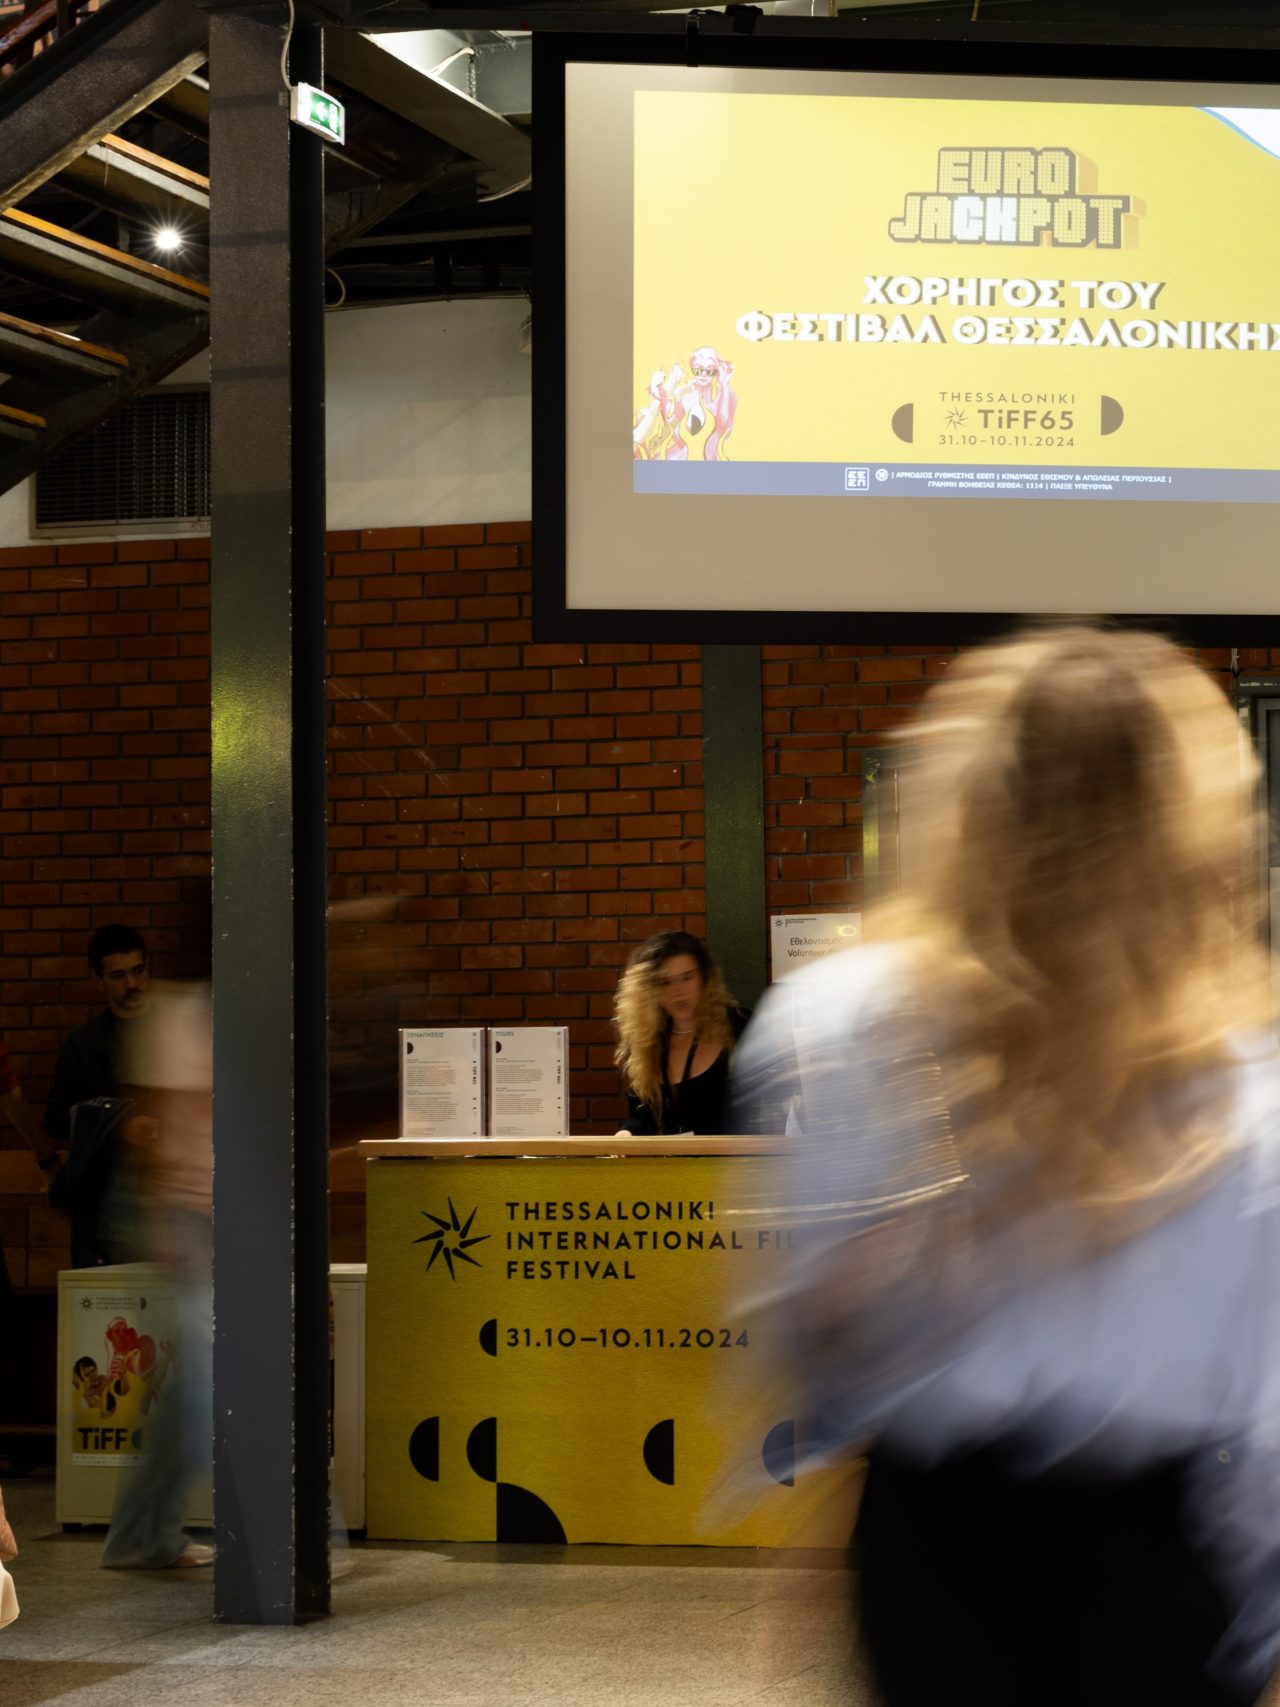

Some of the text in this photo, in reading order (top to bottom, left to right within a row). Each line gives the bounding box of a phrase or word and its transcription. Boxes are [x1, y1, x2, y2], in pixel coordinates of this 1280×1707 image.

[938, 147, 1075, 194] EURO
[889, 193, 1130, 248] JACKPOT
[863, 276, 1166, 310] ΧΟΡΗΓΟΣ ΤΟΥ
[736, 310, 947, 344] ΦΕΣΤΙΒΑΛ
[939, 391, 1075, 404] THESSALONIKI
[977, 409, 1074, 430] TiFF65
[788, 949, 825, 957] Volunteer
[506, 1201, 714, 1221] THESSALONIKI
[506, 1231, 799, 1250] INTERNATIONAL FIL
[506, 1261, 636, 1280] FESTIVAL
[77, 1427, 128, 1450] TiFF
